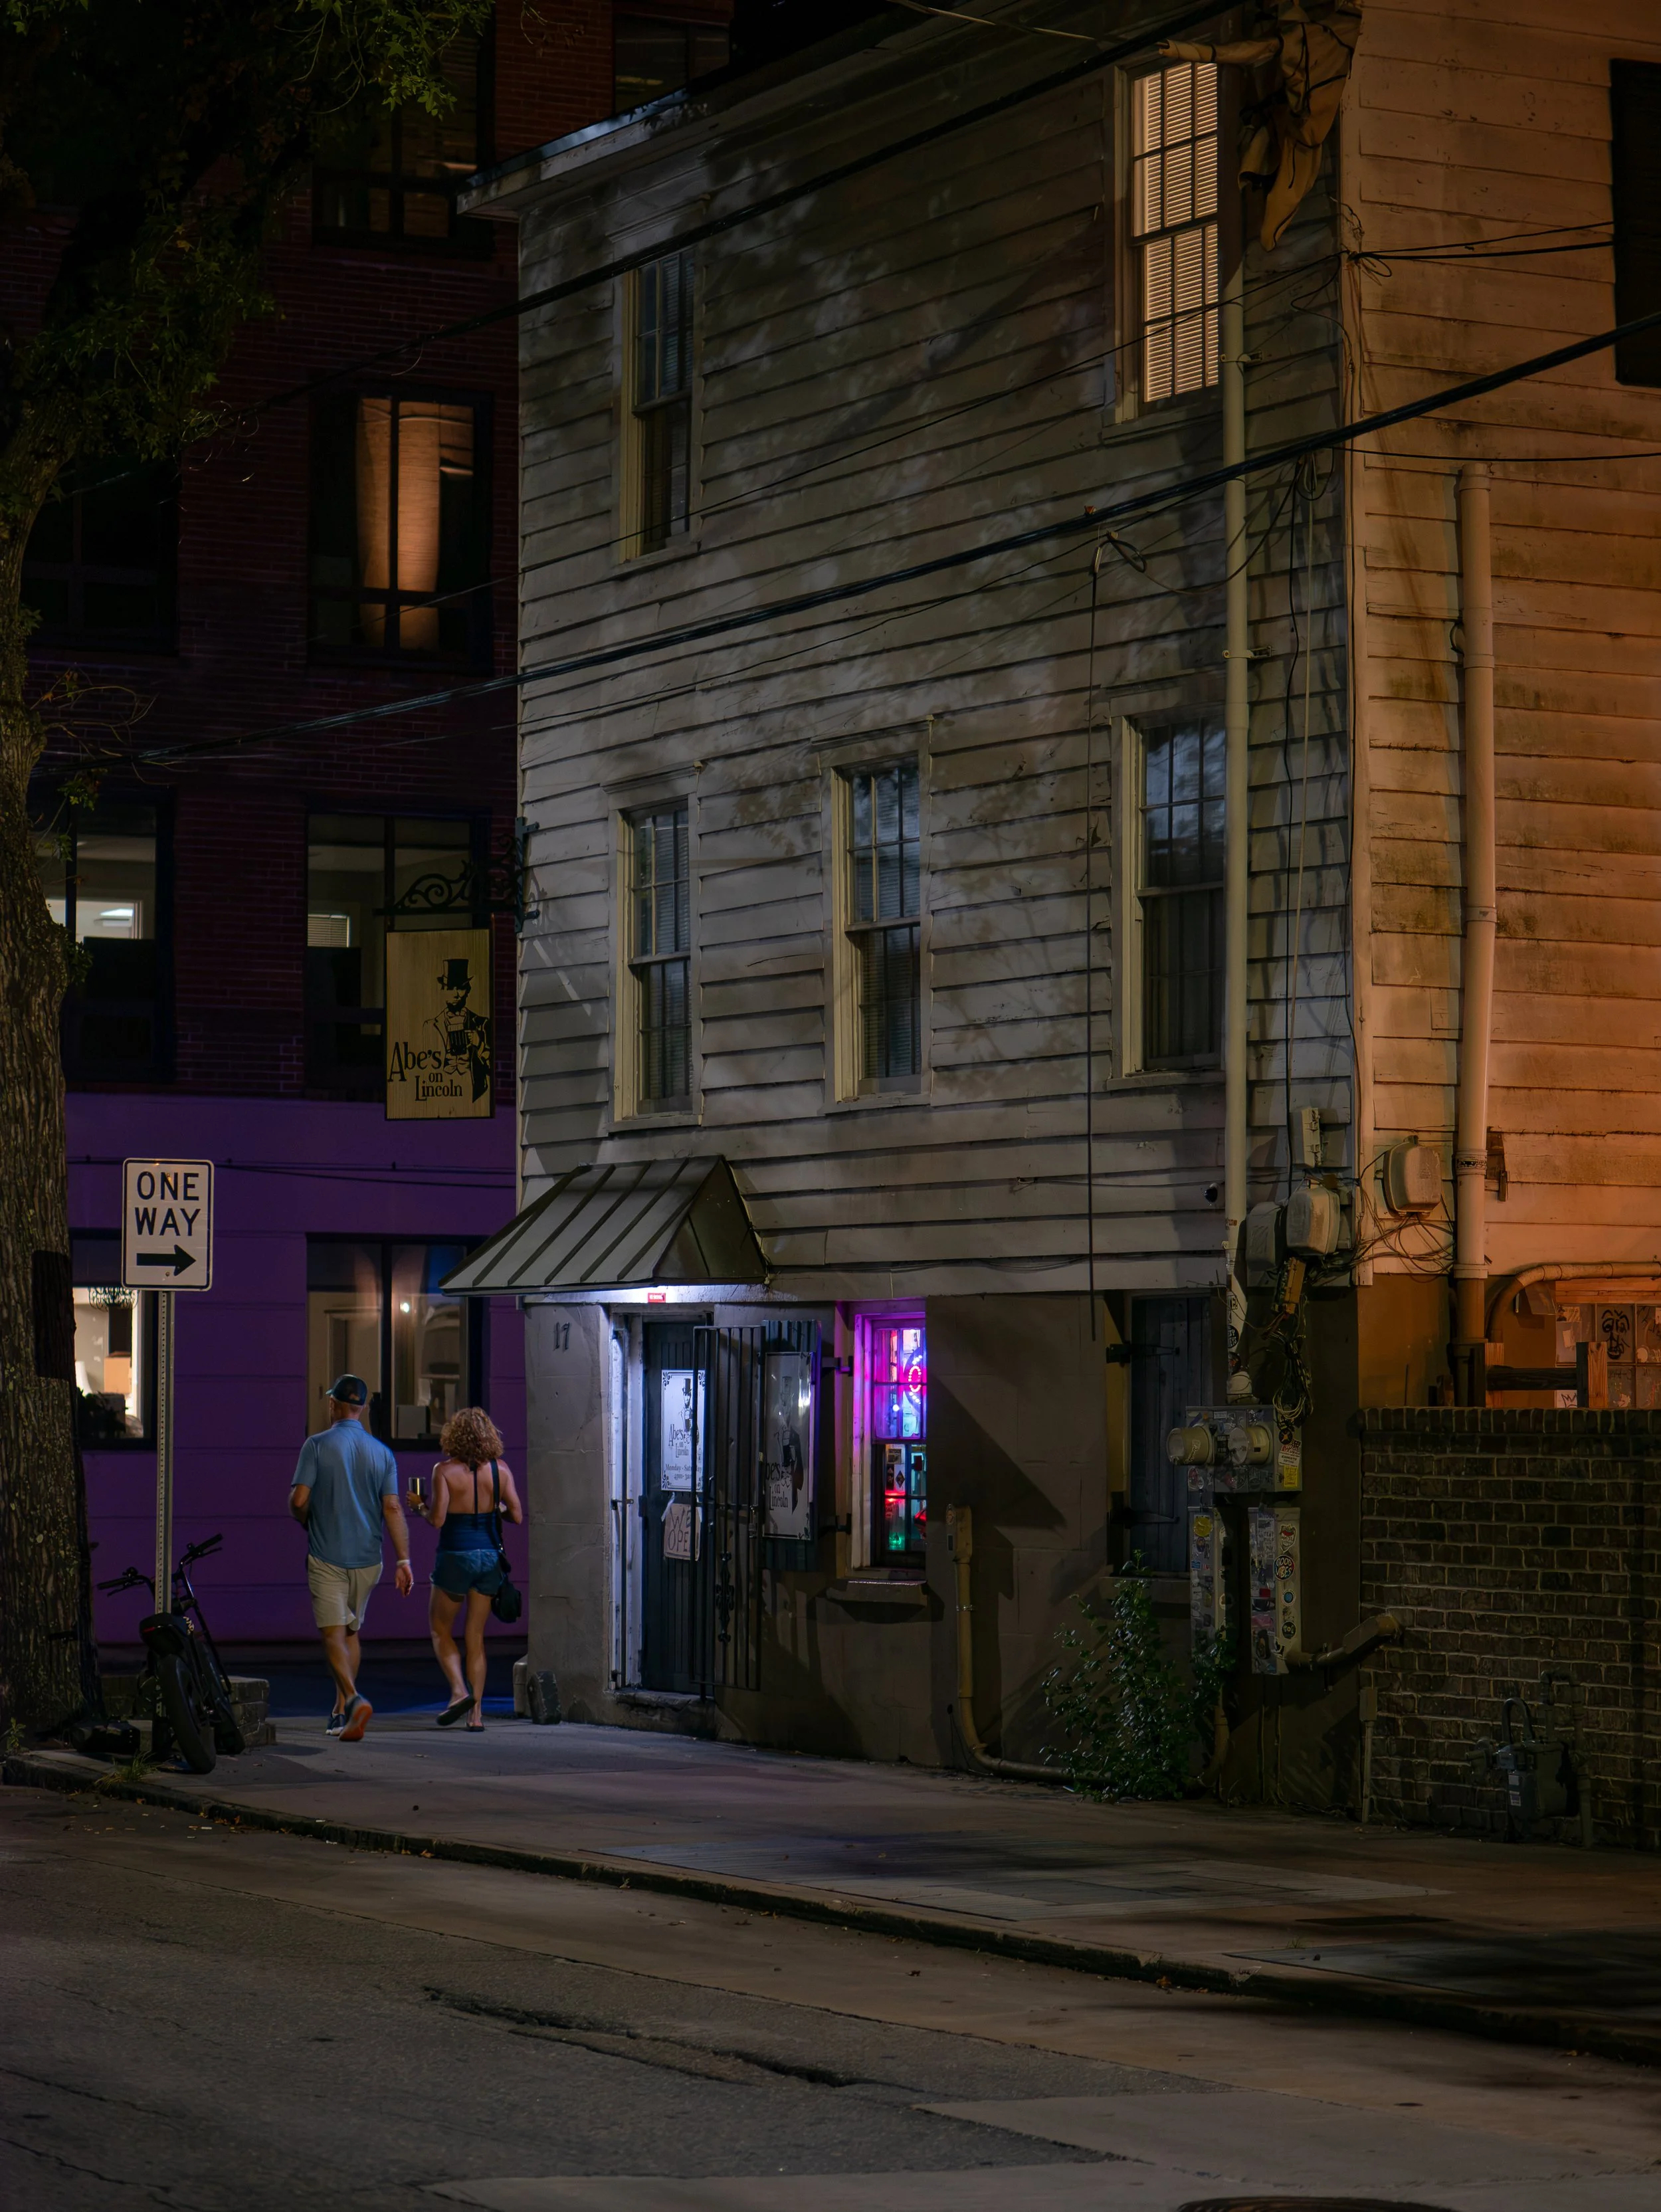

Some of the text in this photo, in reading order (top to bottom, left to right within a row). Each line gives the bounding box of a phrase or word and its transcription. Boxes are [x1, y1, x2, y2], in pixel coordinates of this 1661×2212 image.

[387, 1041, 442, 1082] Abe's
[415, 1075, 463, 1101] Lincoln
[429, 1071, 443, 1082] on
[137, 1171, 199, 1201] ONE
[134, 1207, 201, 1237] WAY
[555, 1322, 570, 1350] 17
[668, 1424, 683, 1447] Abe's
[676, 1443, 689, 1458] Lincoln
[665, 1464, 681, 1472] Monday
[765, 1462, 781, 1481] be's
[769, 1486, 788, 1510] Lincoln
[775, 1484, 781, 1494] on
